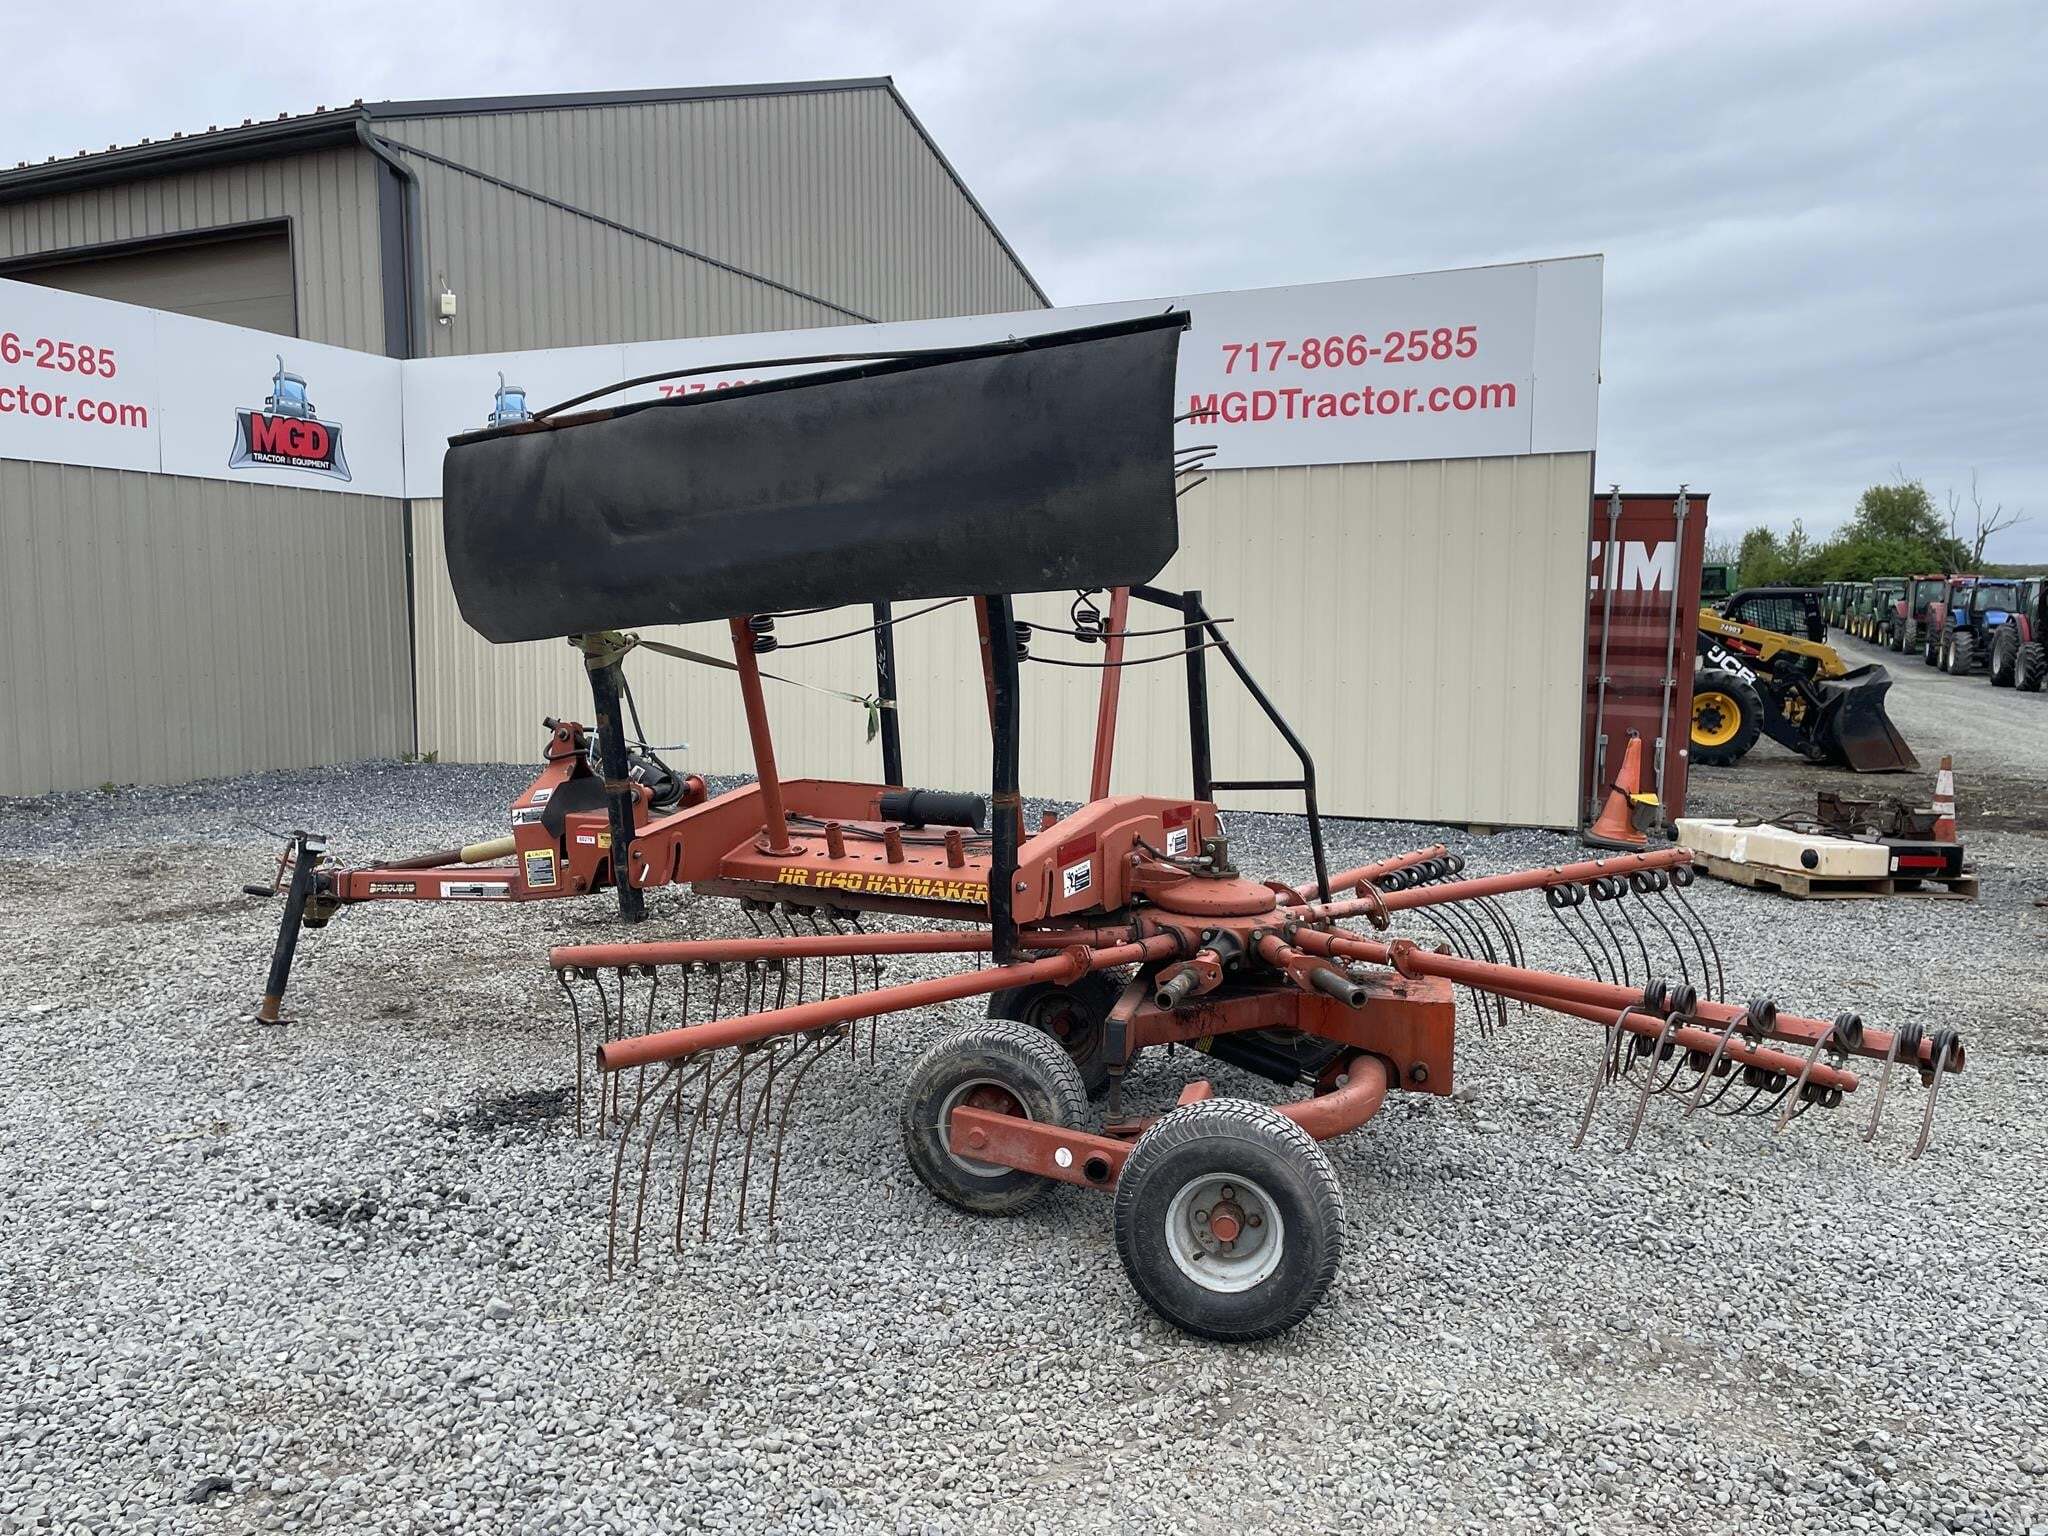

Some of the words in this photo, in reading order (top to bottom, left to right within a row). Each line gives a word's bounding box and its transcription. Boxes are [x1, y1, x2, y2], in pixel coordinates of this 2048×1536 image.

[0, 332, 116, 378] 6-2585
[1222, 325, 1478, 374] 717-866-2585
[0, 385, 148, 428] ctor.com
[1190, 381, 1517, 425] MGDTractor.com
[250, 412, 329, 459] MGD
[253, 453, 286, 464] TRACTOR
[292, 457, 330, 469] EQUIPMENT
[778, 867, 809, 886] HR
[866, 873, 988, 900] HAYMAKER
